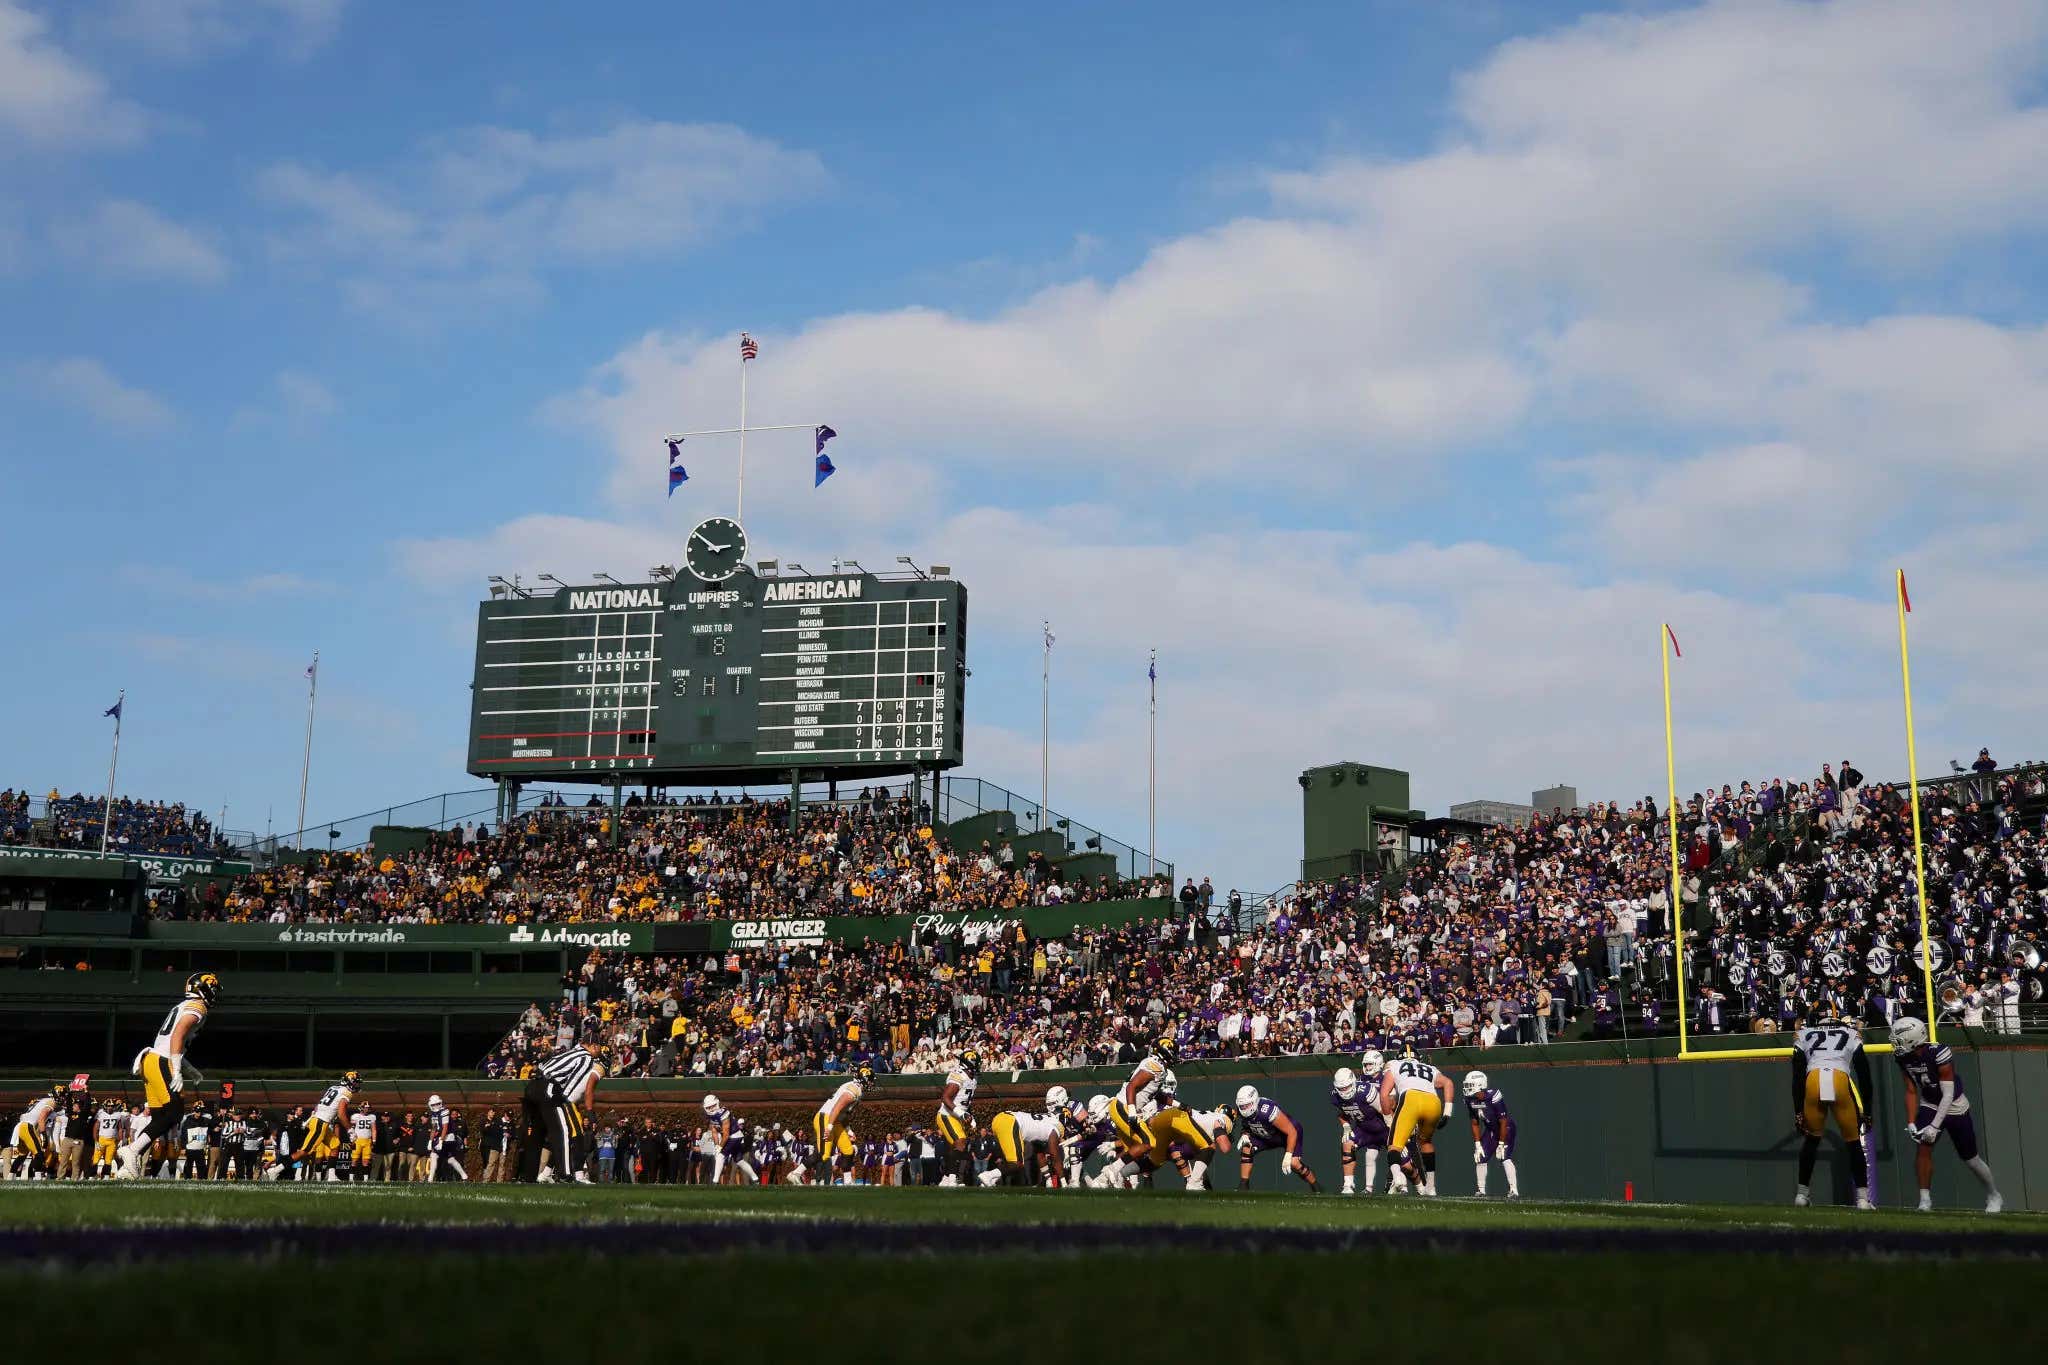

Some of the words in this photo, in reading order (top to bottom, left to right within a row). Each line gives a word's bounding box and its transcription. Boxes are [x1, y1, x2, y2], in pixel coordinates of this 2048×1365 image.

[764, 579, 862, 601] AMERICAN
[570, 588, 664, 610] NATIONAL
[688, 590, 740, 604] UMPIRES
[670, 603, 687, 611] PLATE
[800, 606, 822, 616] PURDUE
[692, 624, 713, 633] YARDS
[714, 624, 722, 632] TO
[724, 624, 733, 632] GO
[798, 618, 824, 628] MICHIGAN
[798, 630, 820, 640] ILLINOIS
[798, 642, 828, 652] MINNESOTA
[797, 654, 811, 664] PENN
[812, 654, 828, 663] STATE
[672, 669, 690, 678] DOWN
[726, 666, 752, 676] QUARTER
[796, 667, 825, 676] MARYLAND
[673, 678, 686, 697] 3
[796, 680, 824, 688] NEBRASKA
[576, 686, 648, 696] NOVEMBER
[798, 692, 822, 700] MICHIGAN
[824, 691, 840, 700] STATE
[794, 704, 808, 712] OHIO
[808, 704, 824, 712] STATE
[856, 703, 862, 712] 7
[916, 700, 924, 709] 14
[794, 716, 818, 725] RUTGERS
[856, 715, 862, 724] 0
[876, 714, 882, 723] 9
[897, 714, 903, 722] 0
[916, 713, 922, 722] 7
[794, 728, 824, 737] WISCONSIN
[856, 727, 862, 736] 0
[876, 727, 882, 736] 7
[916, 726, 922, 735] 0
[794, 741, 816, 750] INDIANA
[856, 740, 861, 748] 7
[895, 739, 902, 748] 0
[916, 738, 921, 747] 3
[512, 748, 553, 758] NORTHWESTERN
[856, 752, 861, 761] 1
[875, 752, 881, 761] 2
[895, 752, 902, 760] 3
[915, 751, 921, 760] 4
[935, 751, 942, 760] F
[570, 760, 576, 769] 1
[590, 760, 597, 769] 2
[609, 759, 616, 768] 3
[627, 759, 634, 768] 4
[647, 758, 654, 767] F
[730, 920, 826, 938] GRAINGER
[915, 913, 1019, 936] Budeisr
[295, 928, 406, 943] tastytrade
[540, 928, 631, 948] Advocate
[1642, 1008, 1652, 1018] 94
[1805, 1030, 1850, 1056] 27
[1399, 1062, 1434, 1082] 48
[222, 1084, 233, 1099] 3
[103, 1119, 118, 1130] 37
[358, 1119, 372, 1130] 95
